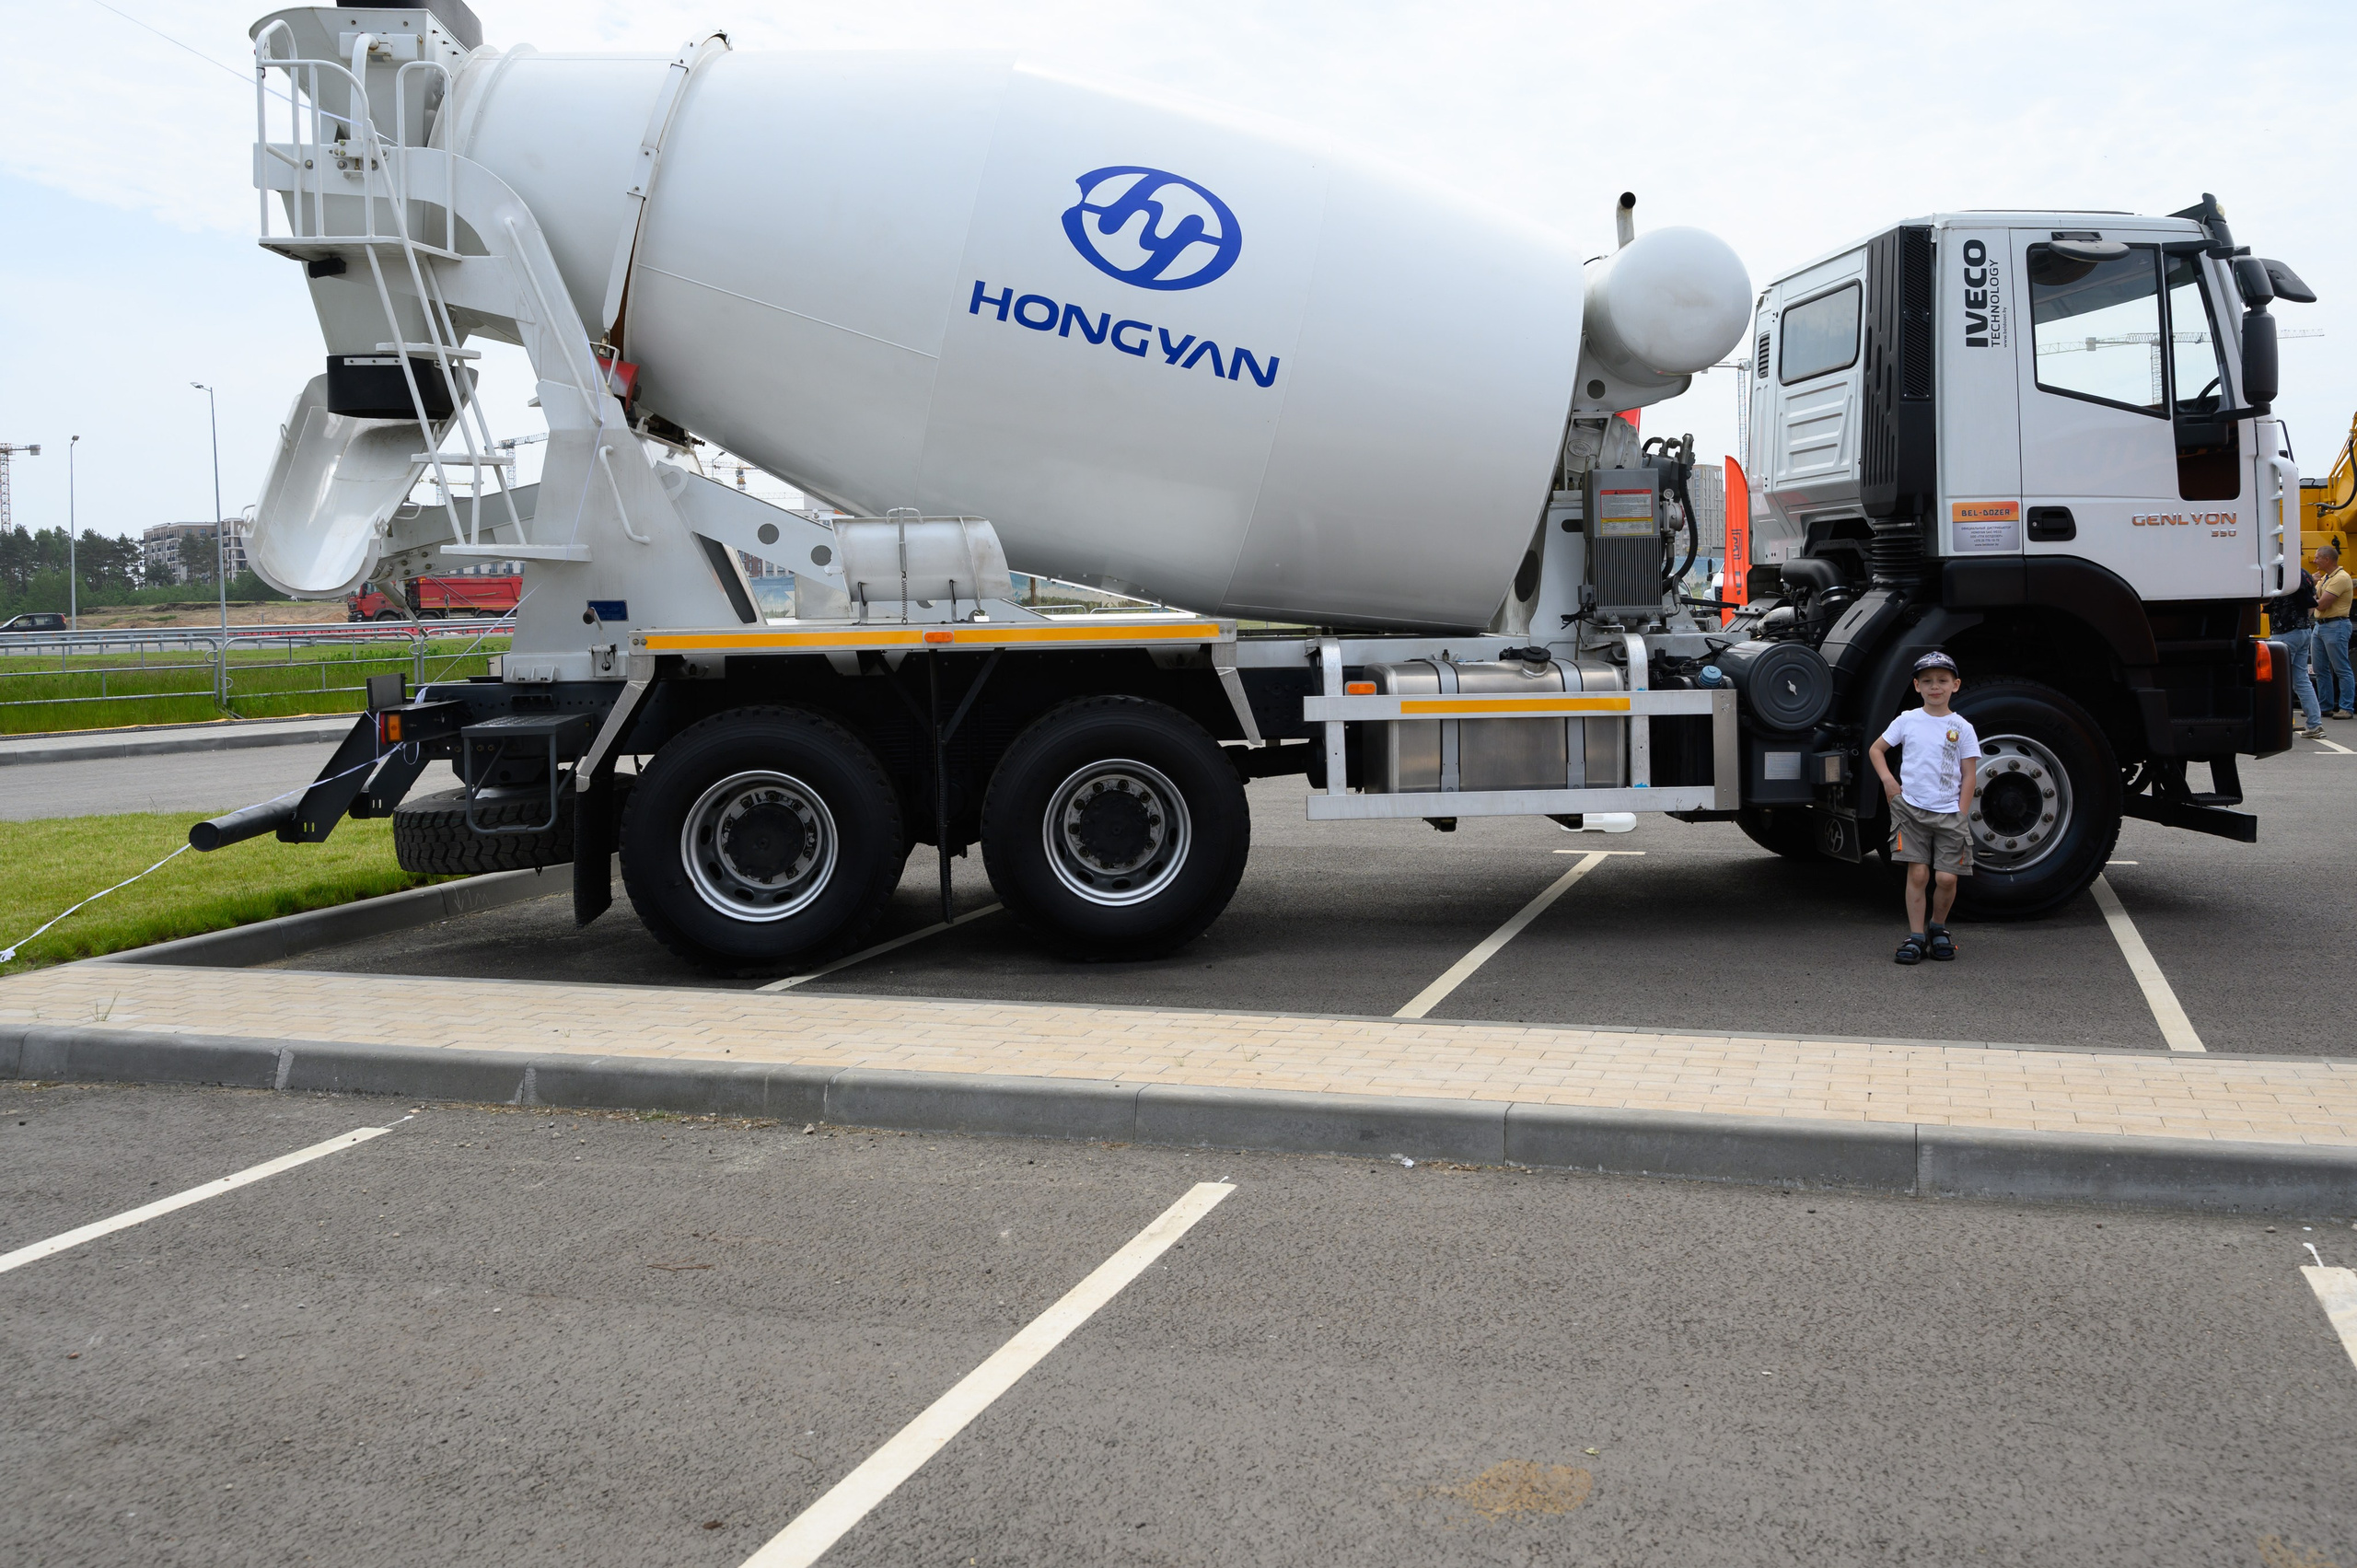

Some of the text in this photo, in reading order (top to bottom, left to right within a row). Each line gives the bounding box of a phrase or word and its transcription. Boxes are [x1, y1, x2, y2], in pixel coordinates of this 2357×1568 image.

[969, 280, 1280, 388] HONGYAN
[1963, 239, 1988, 347] IVECO
[1990, 259, 2001, 347] TECHNOLOGY
[2131, 511, 2237, 526] GENLYON
